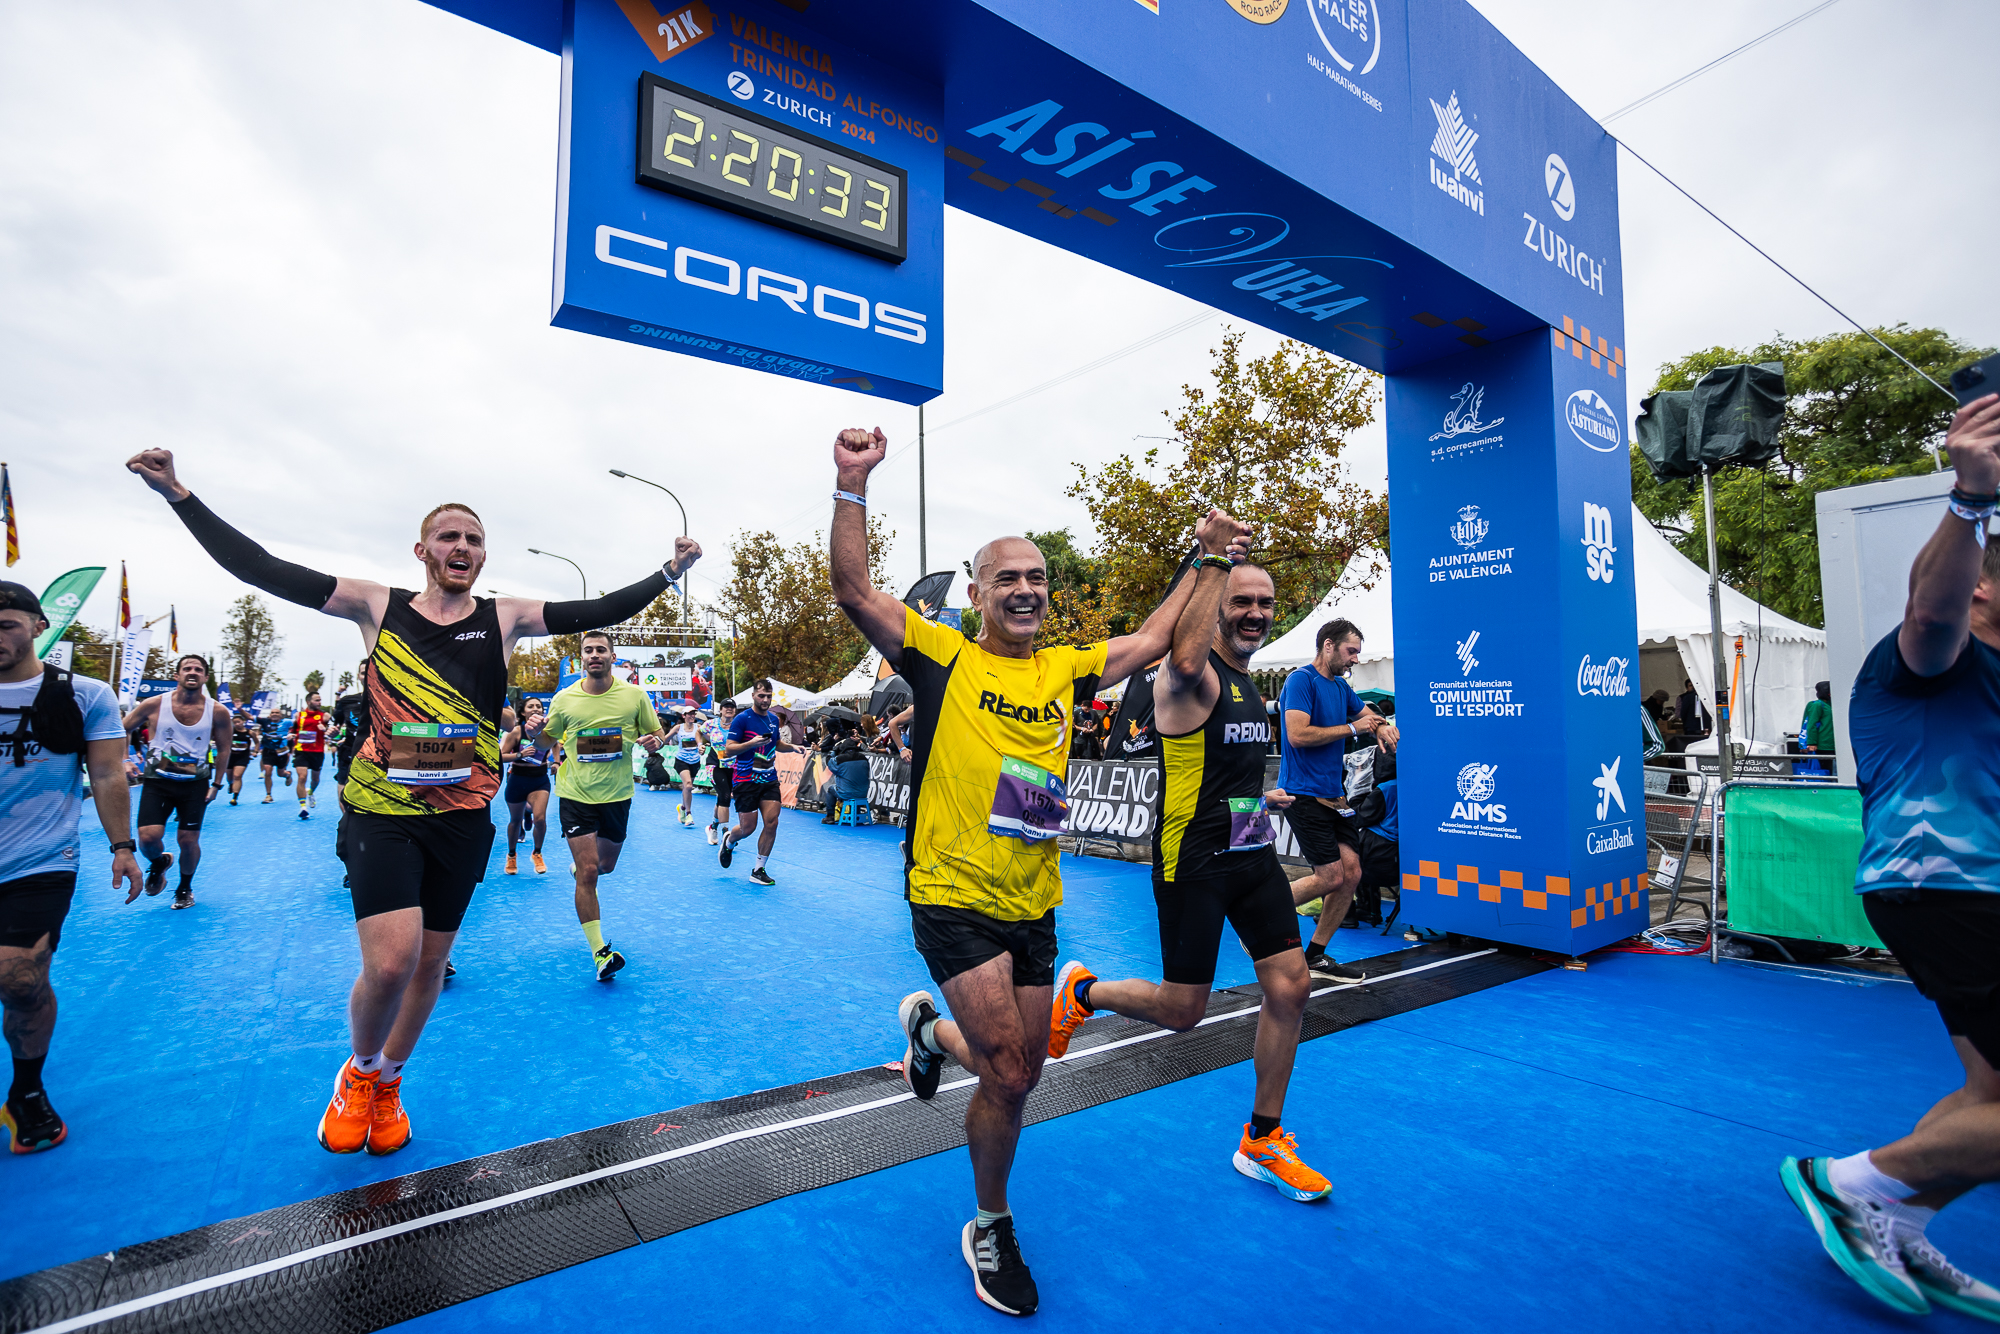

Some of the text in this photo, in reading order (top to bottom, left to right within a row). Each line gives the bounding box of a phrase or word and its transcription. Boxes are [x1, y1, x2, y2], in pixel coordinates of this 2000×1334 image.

[1240, 2, 1264, 17] ROAD
[657, 10, 704, 52] 21K
[729, 12, 834, 77] VALENCIA
[729, 42, 939, 143] TRINIDAD ALFONSO
[1307, 52, 1383, 113] HALF MARATHON SERIES
[763, 88, 876, 144] ZURICH 2024
[663, 108, 892, 232] 2:20:33
[966, 99, 1217, 217] ASÍ SE
[1429, 157, 1485, 217] luanvi
[1522, 211, 1604, 297] ZURICH
[594, 224, 927, 345] COROS
[628, 323, 835, 375] CIUDAD DEL RUNNING
[1570, 403, 1617, 443] ASTURIANA
[1446, 435, 1504, 453] correcaminos
[1429, 547, 1515, 569] AJUNTAMENT
[1429, 563, 1513, 583] DE VALÈNCIA
[1429, 679, 1513, 690] Comunitat Valenciana
[1577, 653, 1630, 697] Coca-Cola
[1429, 689, 1513, 704] COMUNITAT
[1435, 704, 1454, 718] DE
[414, 759, 453, 769] Josemi
[415, 742, 455, 754] 15074
[1441, 821, 1473, 830] Association
[1480, 824, 1518, 833] International
[1450, 801, 1508, 824] AIMS
[1437, 826, 1466, 835] Marathons
[1478, 830, 1504, 838] Distance
[1504, 832, 1522, 840] Races
[1586, 826, 1634, 855] CaixaBank
